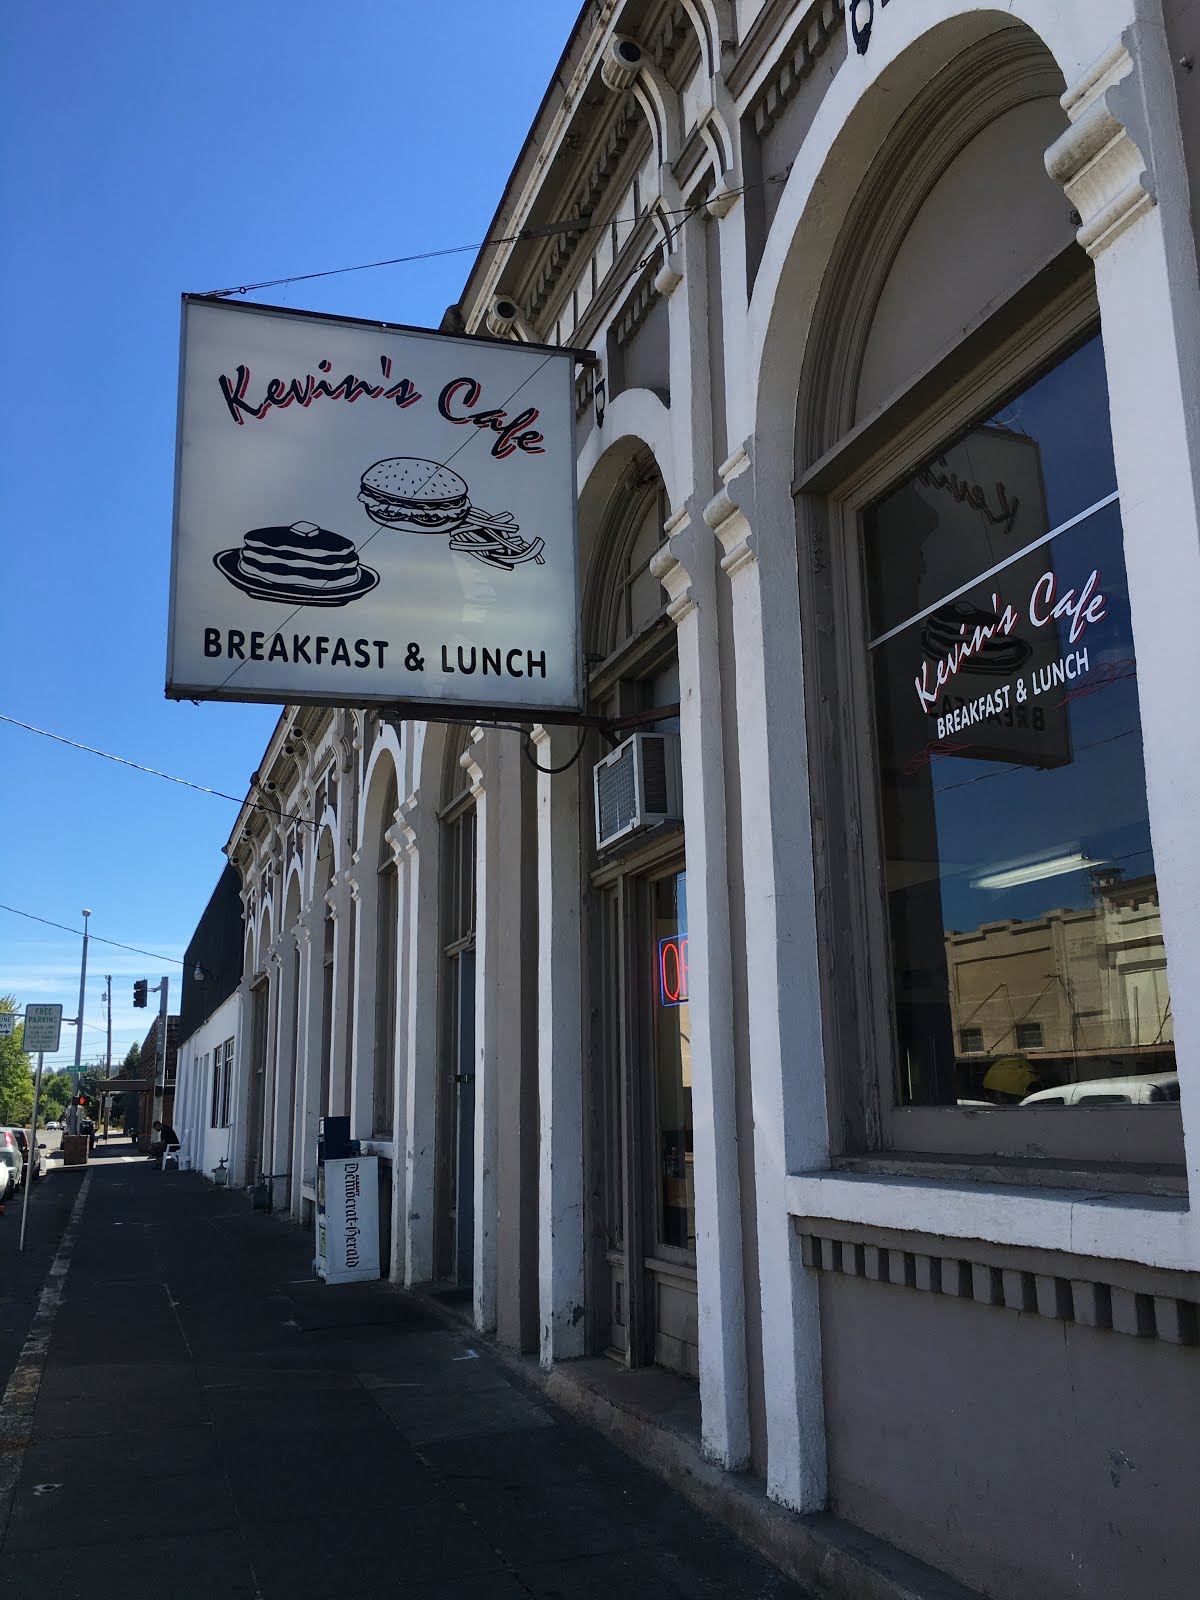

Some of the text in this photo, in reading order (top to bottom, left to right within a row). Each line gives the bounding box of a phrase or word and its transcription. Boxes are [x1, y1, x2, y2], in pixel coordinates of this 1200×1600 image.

[218, 355, 546, 459] Kevin's Cafe
[203, 627, 547, 679] BREAKFAST & LUNCH
[914, 569, 1108, 713] Kevin's Cafe
[936, 646, 1090, 740] BREAKFAST & LUNCH
[28, 1016, 58, 1024] PARKING
[35, 1007, 52, 1015] FREE
[344, 1162, 360, 1268] Democrat-Herald
